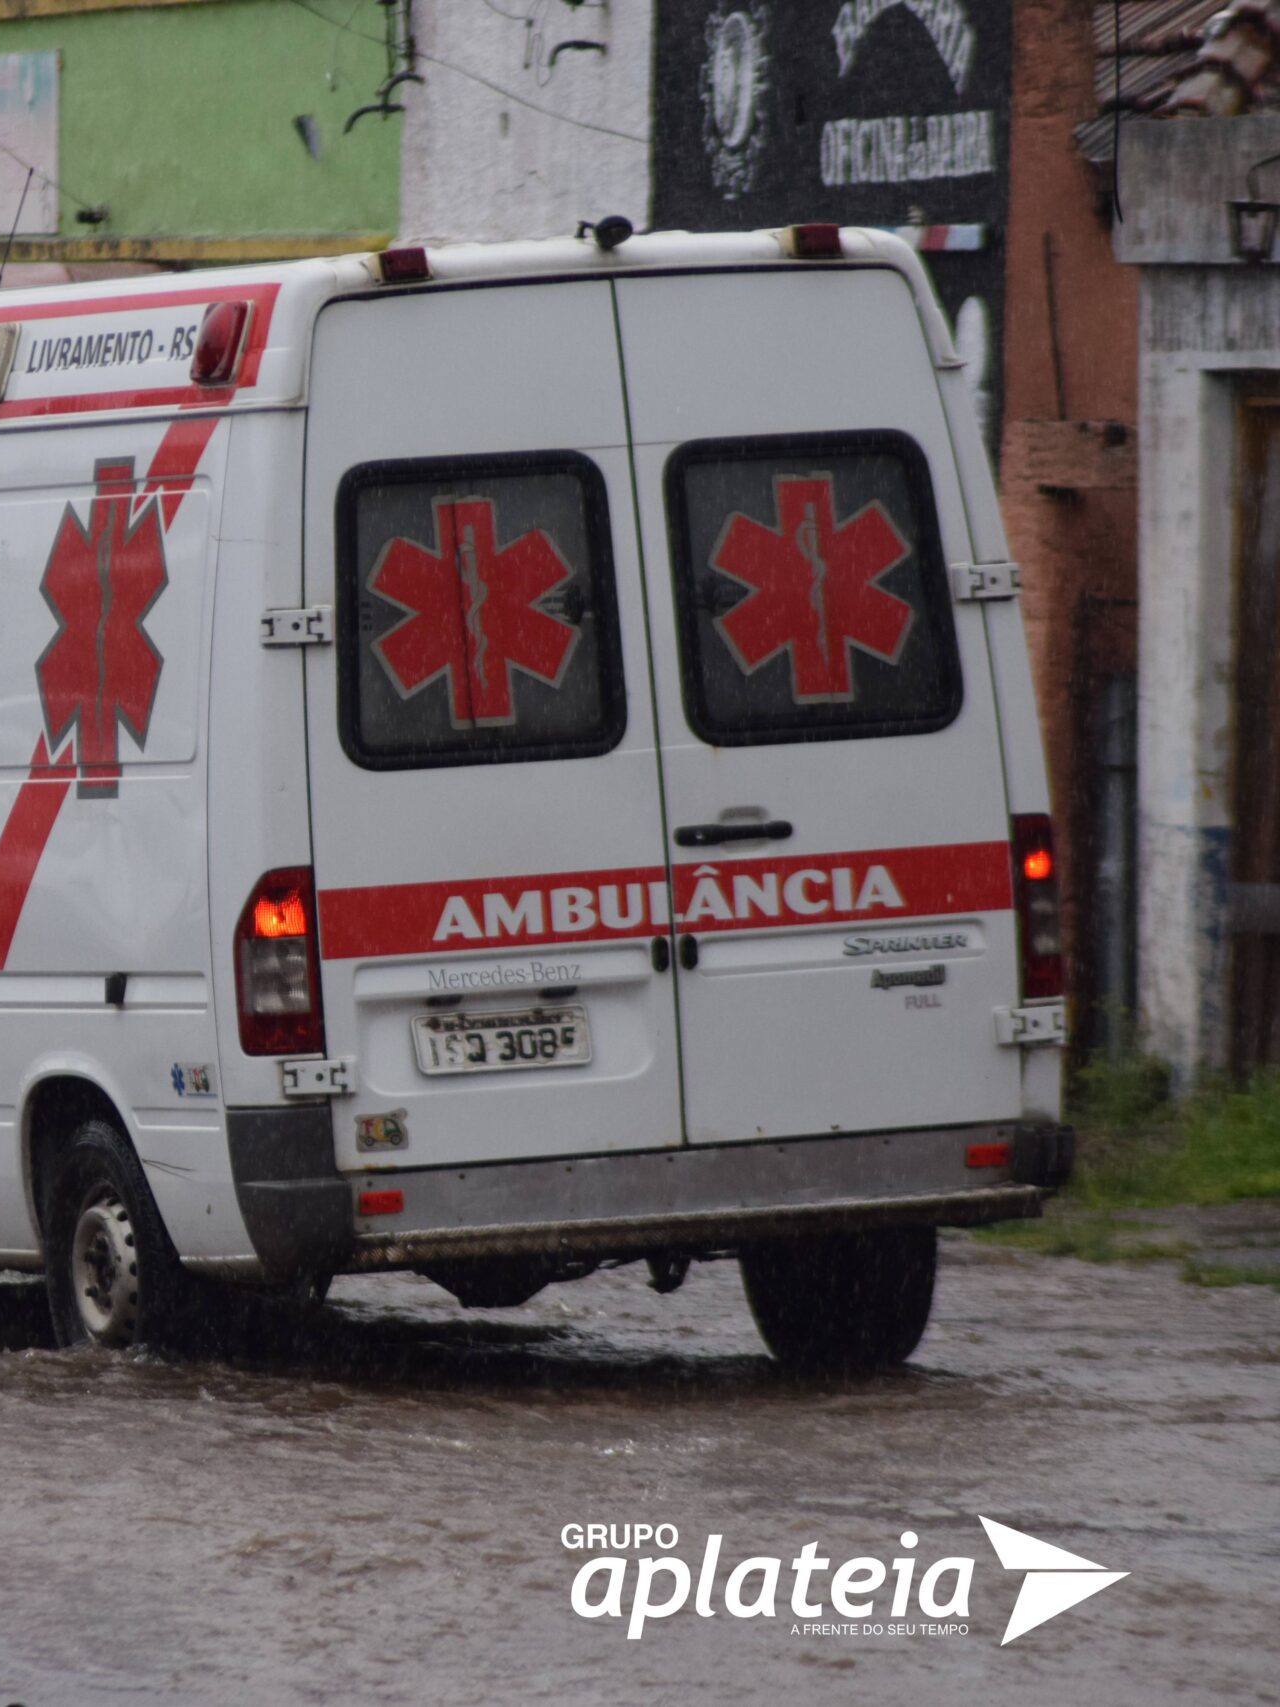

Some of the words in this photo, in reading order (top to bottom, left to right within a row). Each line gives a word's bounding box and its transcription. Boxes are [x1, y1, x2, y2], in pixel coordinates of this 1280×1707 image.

[26, 328, 154, 375] LIVRAMENTO
[168, 324, 198, 362] RS
[433, 864, 905, 942] AMBULÂNCIA
[428, 961, 581, 992] Mercedes-Benz
[904, 993, 943, 1010] FULL
